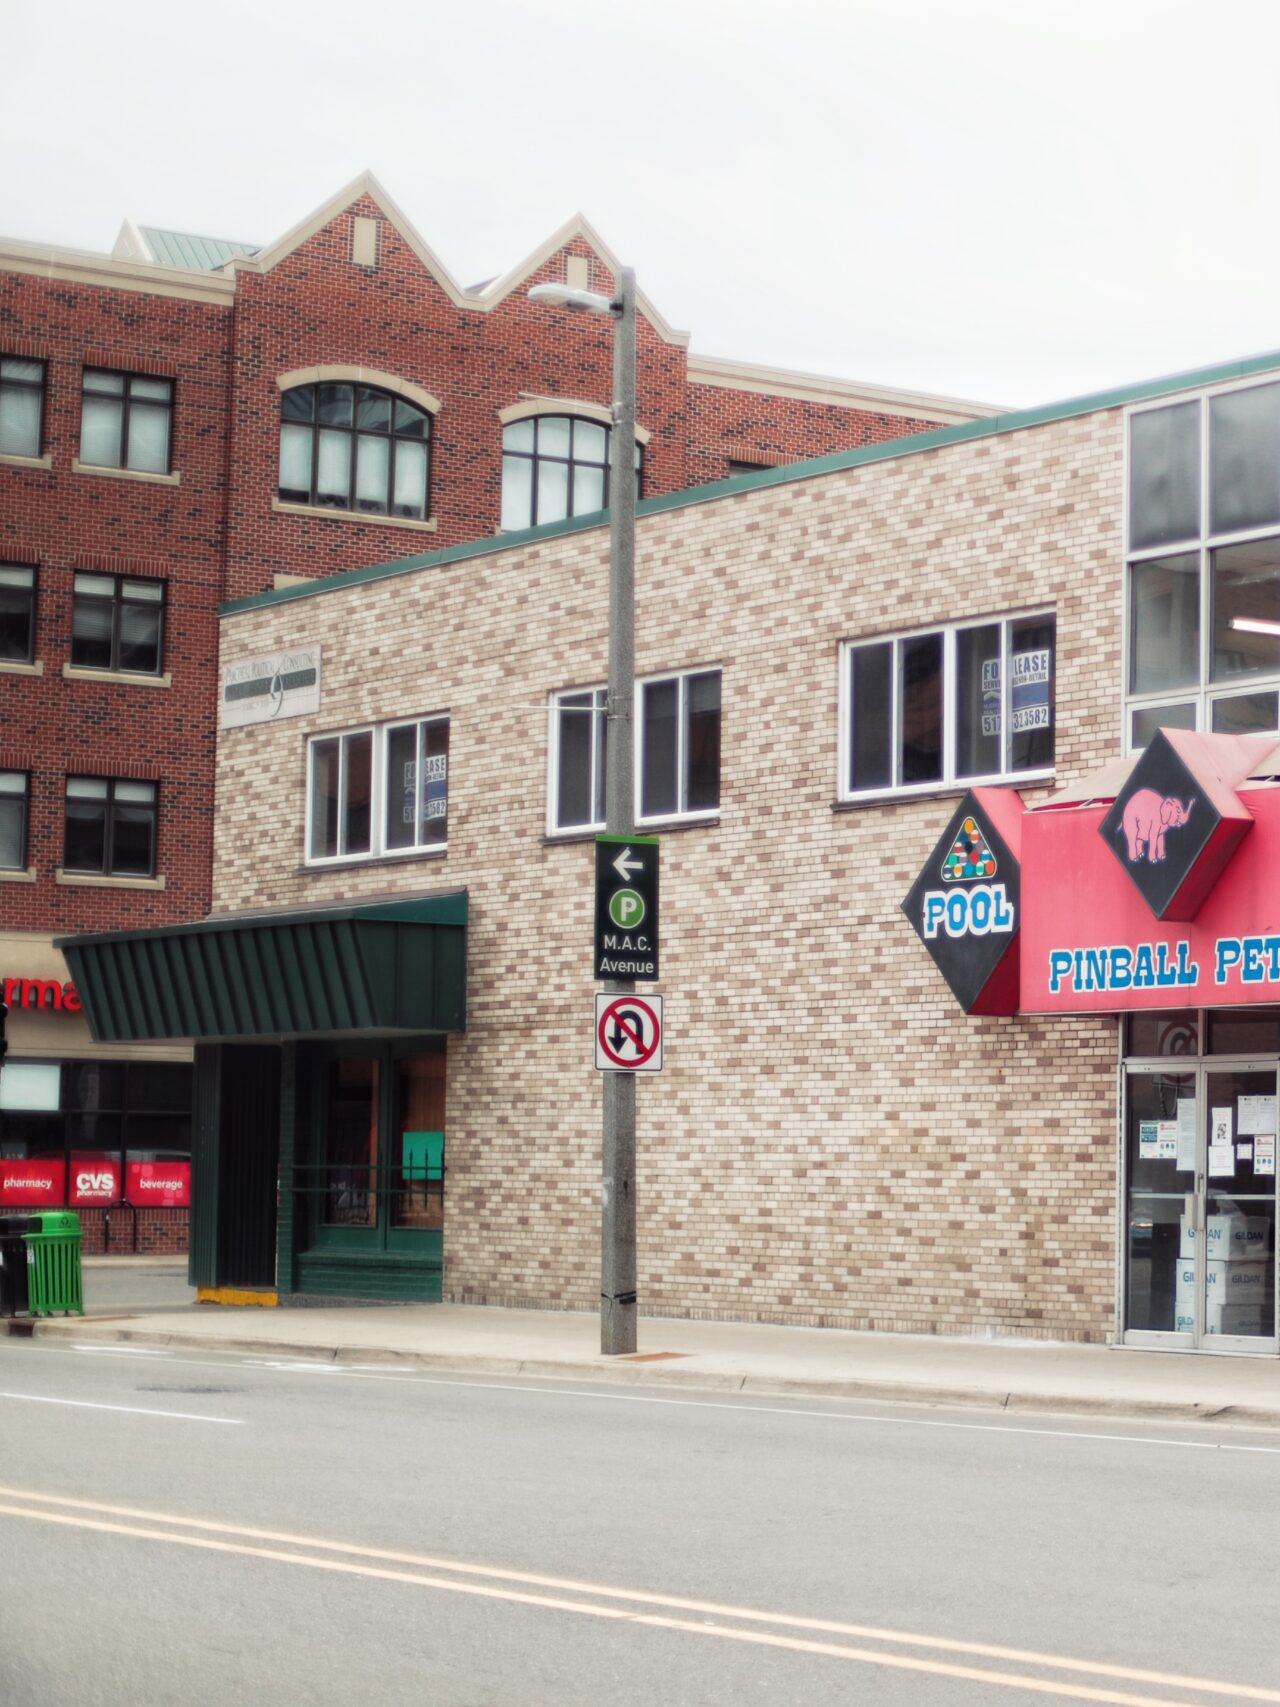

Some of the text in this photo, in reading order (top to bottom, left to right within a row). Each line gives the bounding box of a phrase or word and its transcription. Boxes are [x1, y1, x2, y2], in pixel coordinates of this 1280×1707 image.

[984, 662, 999, 680] FO
[620, 896, 637, 922] P
[923, 884, 1013, 939] POOL
[604, 935, 652, 951] M.A.C.
[600, 957, 654, 974] Avenue
[1048, 941, 1198, 993] PINBALL
[3, 1176, 52, 1189] pharmacy
[76, 1173, 114, 1190] CVS
[140, 1178, 183, 1190] beverage
[77, 1189, 113, 1198] pharmacy
[1188, 1228, 1221, 1239] GAN
[1235, 1231, 1264, 1240] GILDAN
[1232, 1274, 1261, 1283] GILDAN
